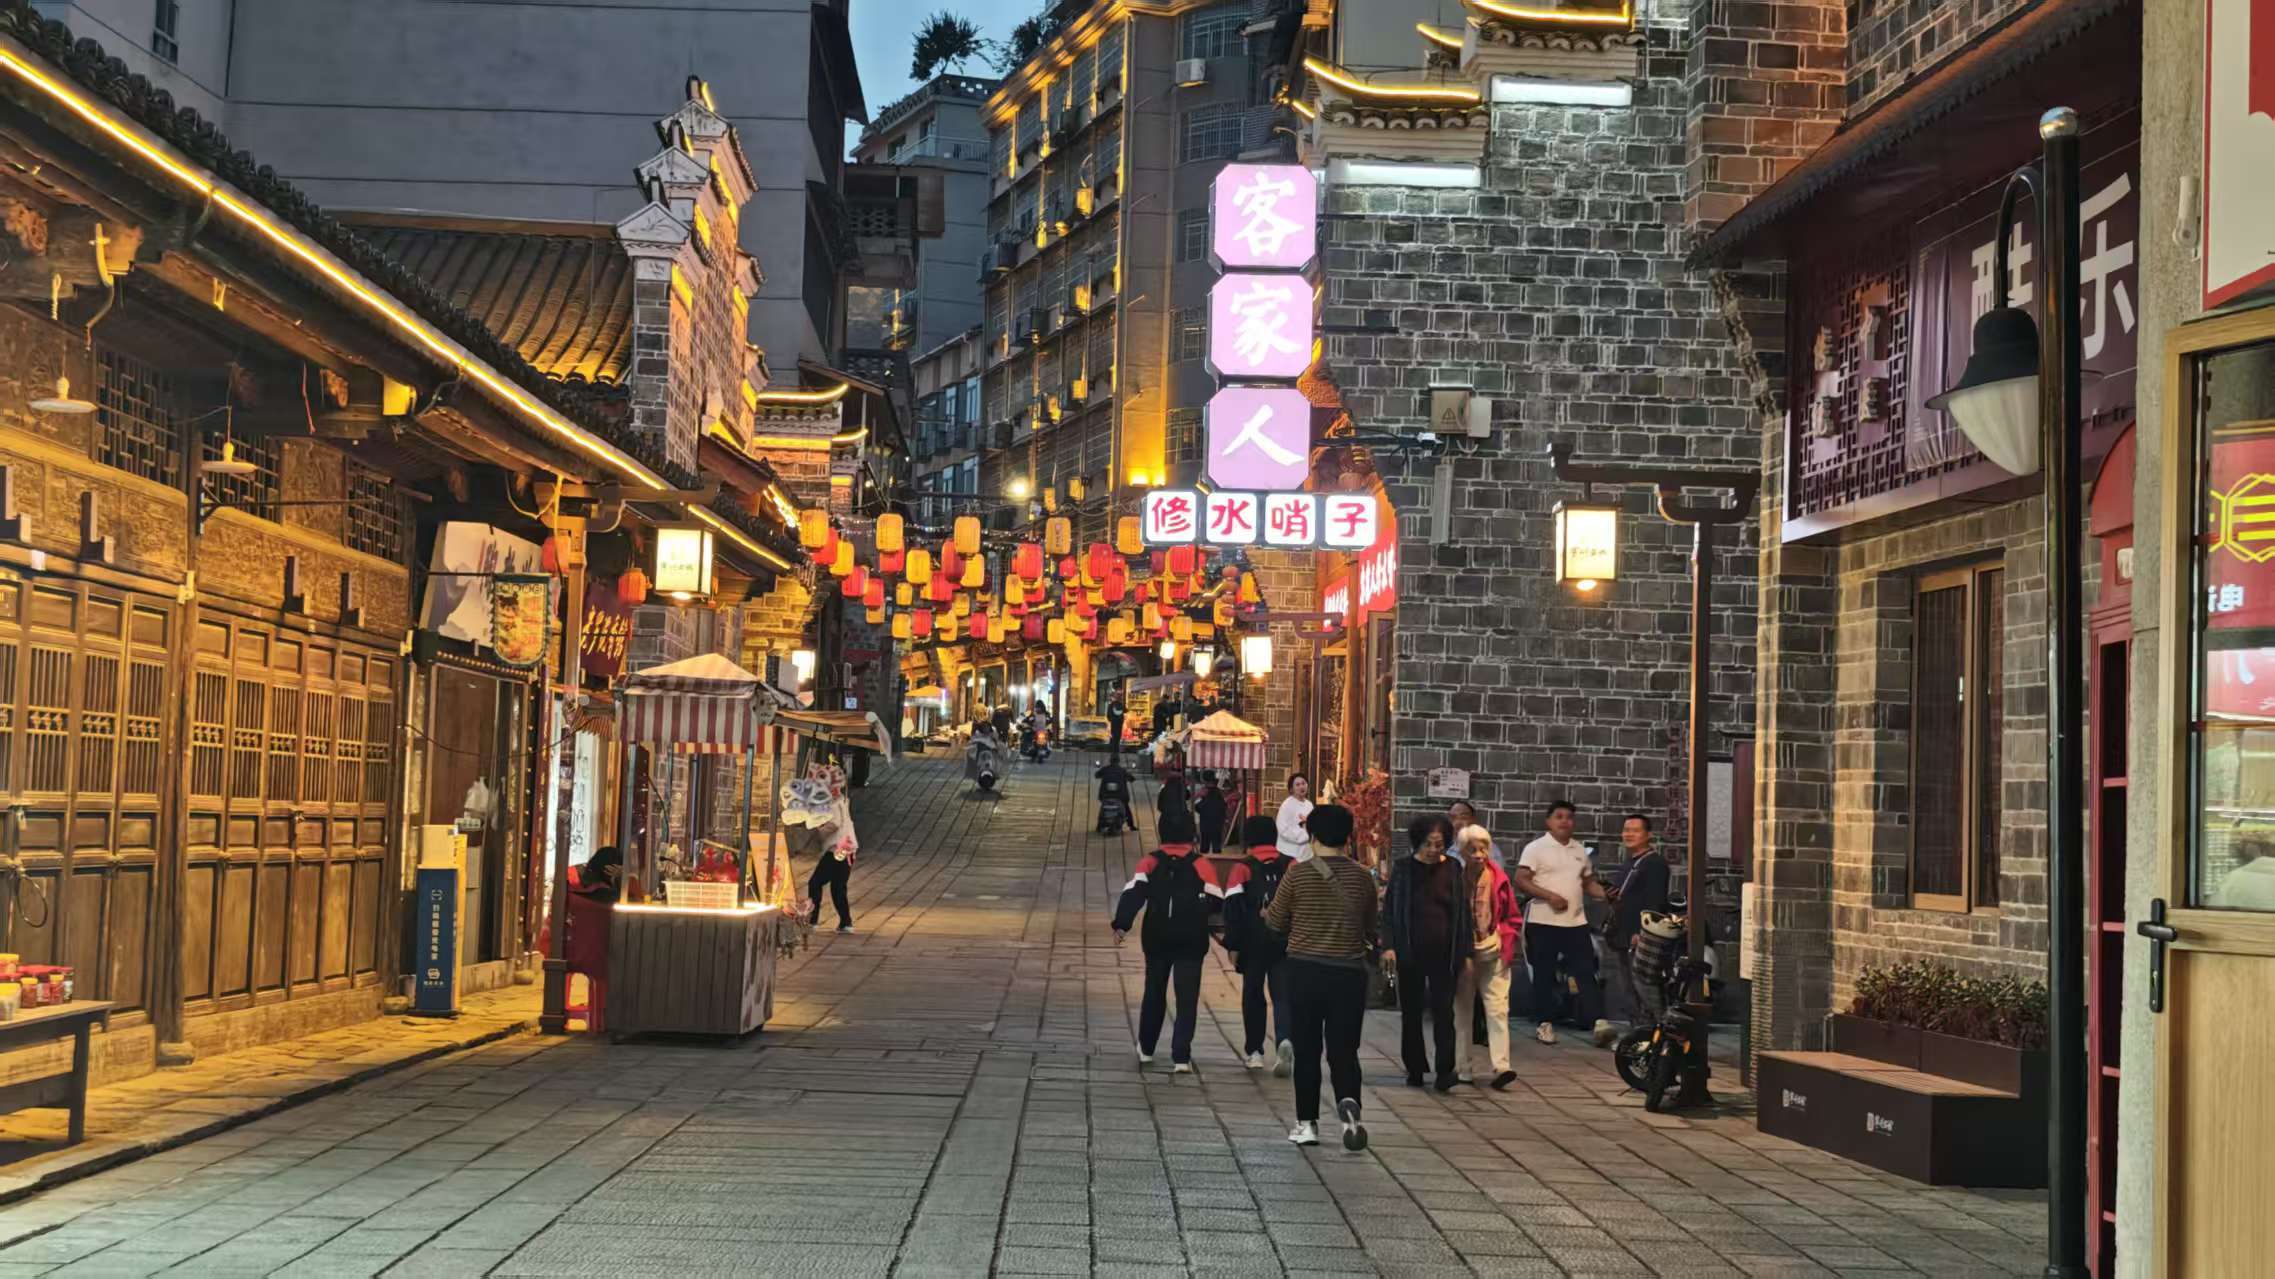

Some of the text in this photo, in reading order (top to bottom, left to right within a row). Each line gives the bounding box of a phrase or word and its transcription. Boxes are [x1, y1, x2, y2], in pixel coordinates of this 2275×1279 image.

[1221, 172, 1304, 467] 客家人
[1151, 496, 1368, 541] 修水哨子
